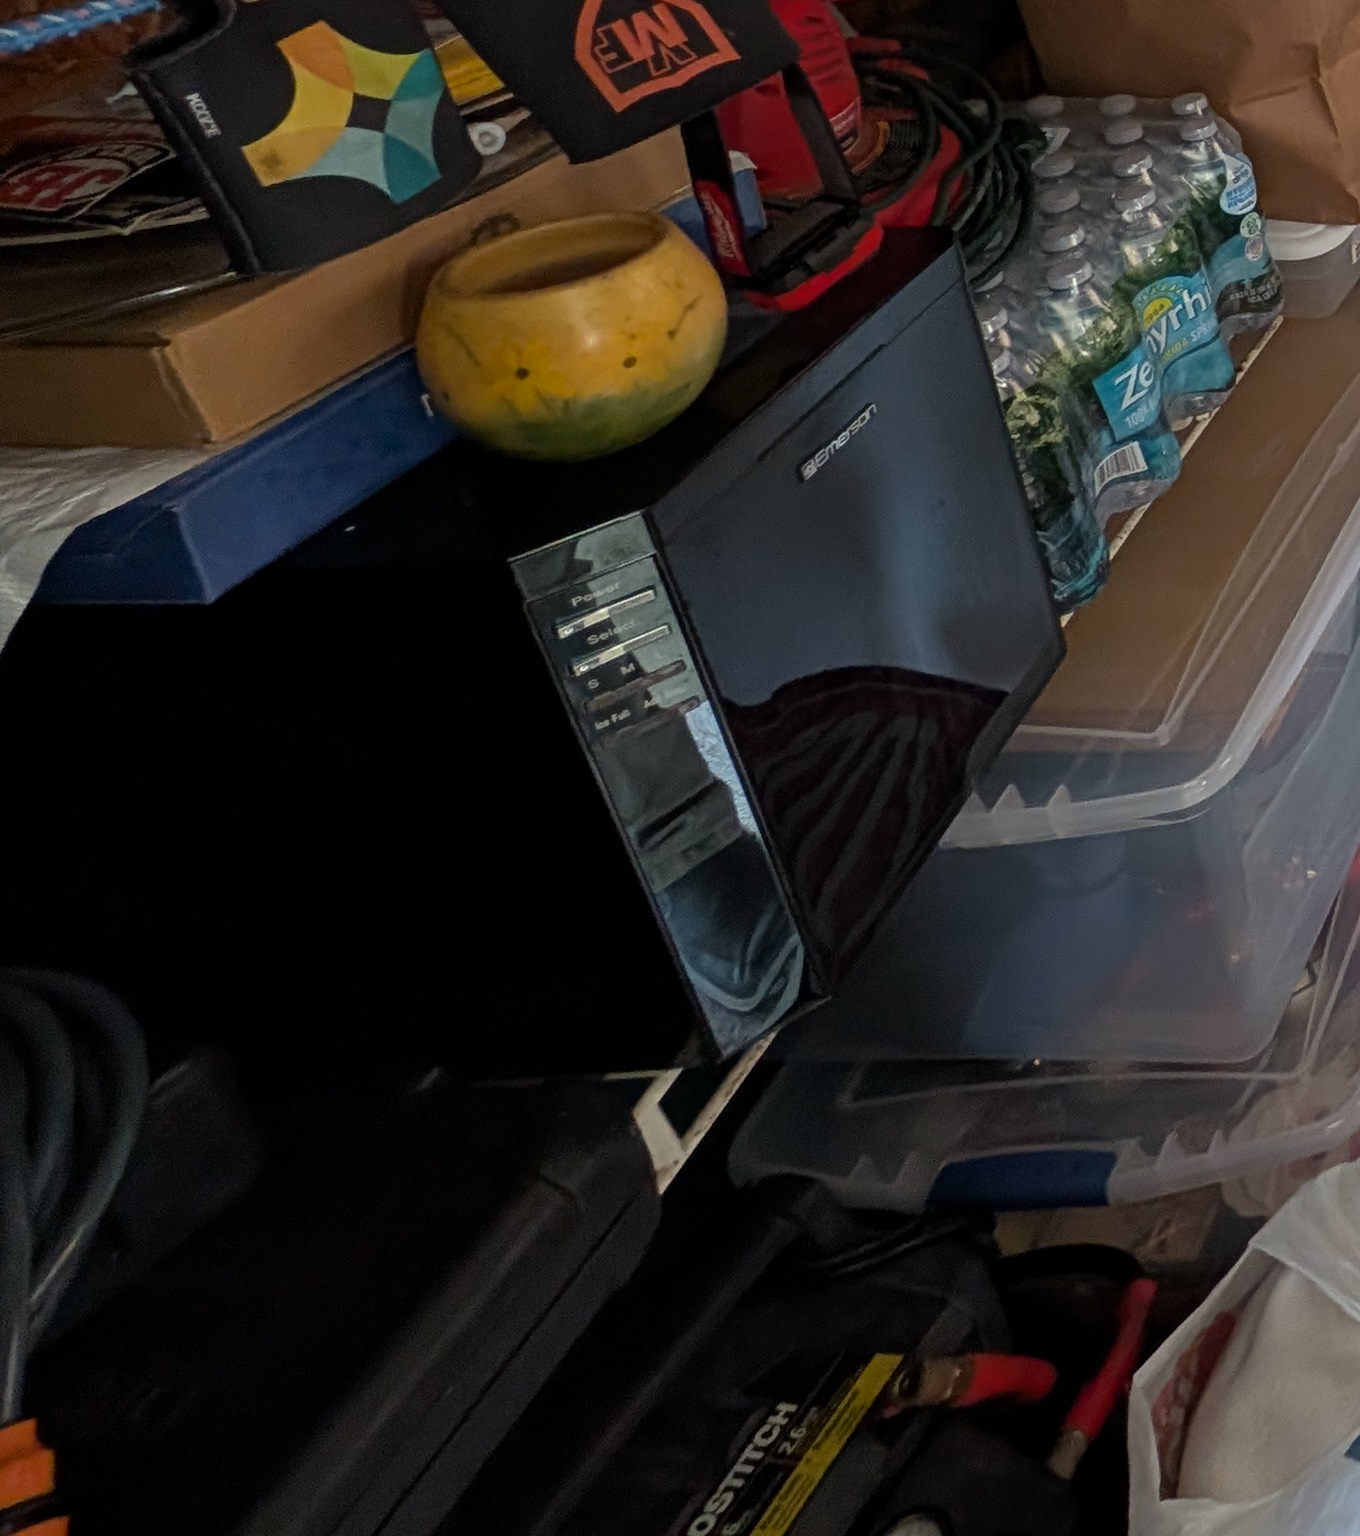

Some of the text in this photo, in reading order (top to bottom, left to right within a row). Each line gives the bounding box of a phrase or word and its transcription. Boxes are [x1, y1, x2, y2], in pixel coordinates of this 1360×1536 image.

[815, 403, 877, 468] Emerson
[571, 581, 621, 607] Power
[586, 619, 637, 646] Select
[587, 663, 636, 689] S M
[687, 1401, 799, 1536] OSTITCH
